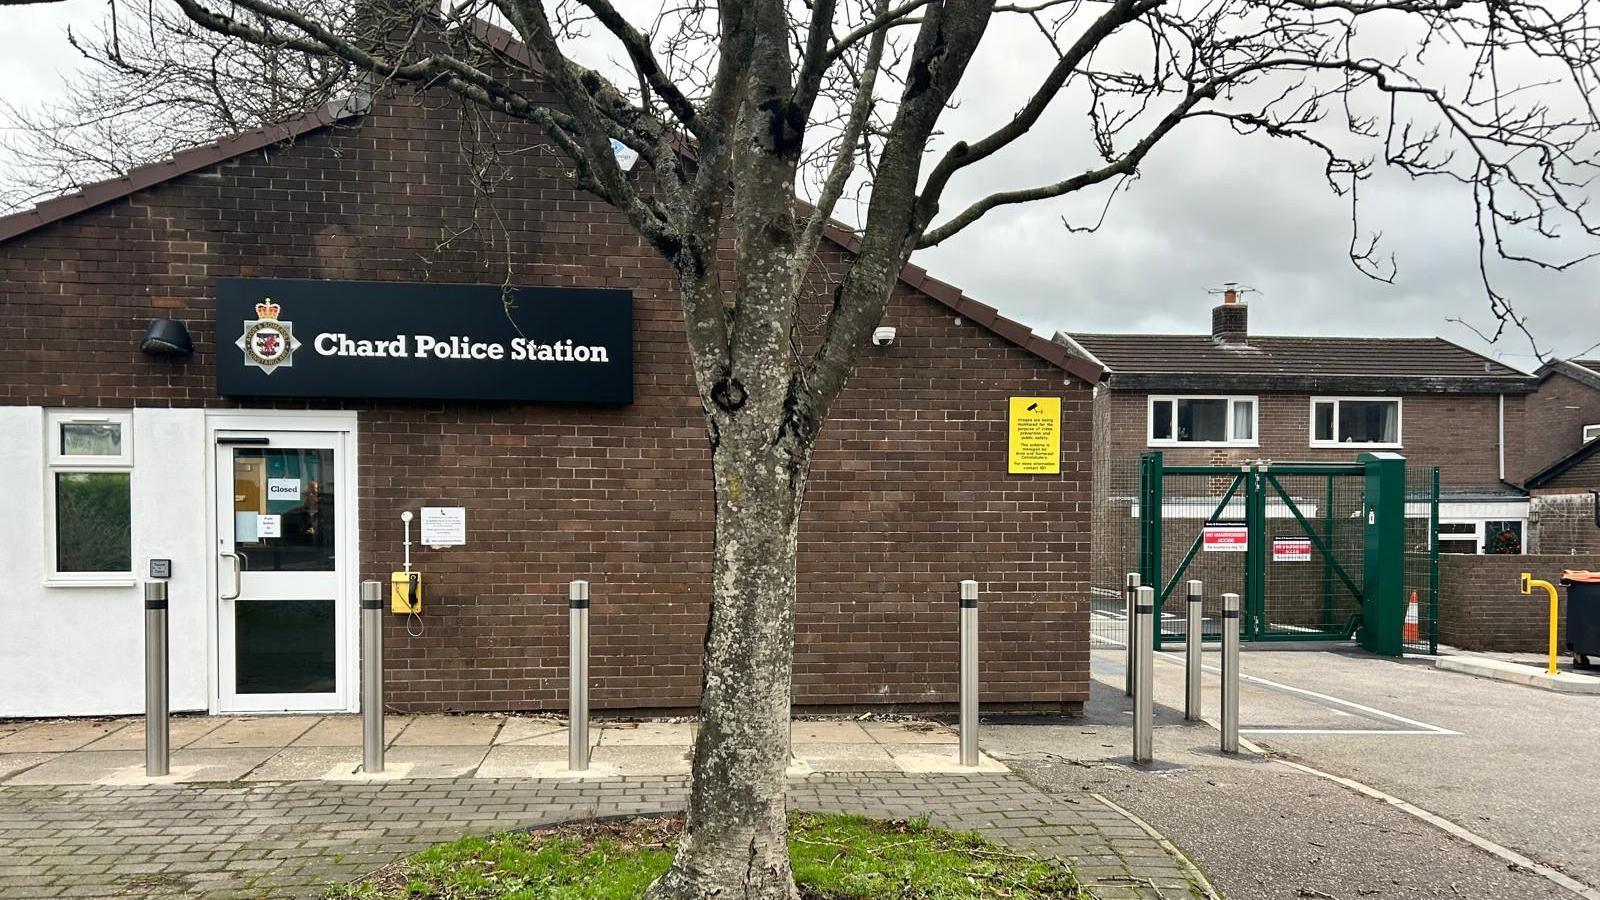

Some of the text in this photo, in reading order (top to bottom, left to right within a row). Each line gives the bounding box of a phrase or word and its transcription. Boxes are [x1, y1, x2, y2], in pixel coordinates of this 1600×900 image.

[314, 332, 608, 362] Chard Police Station
